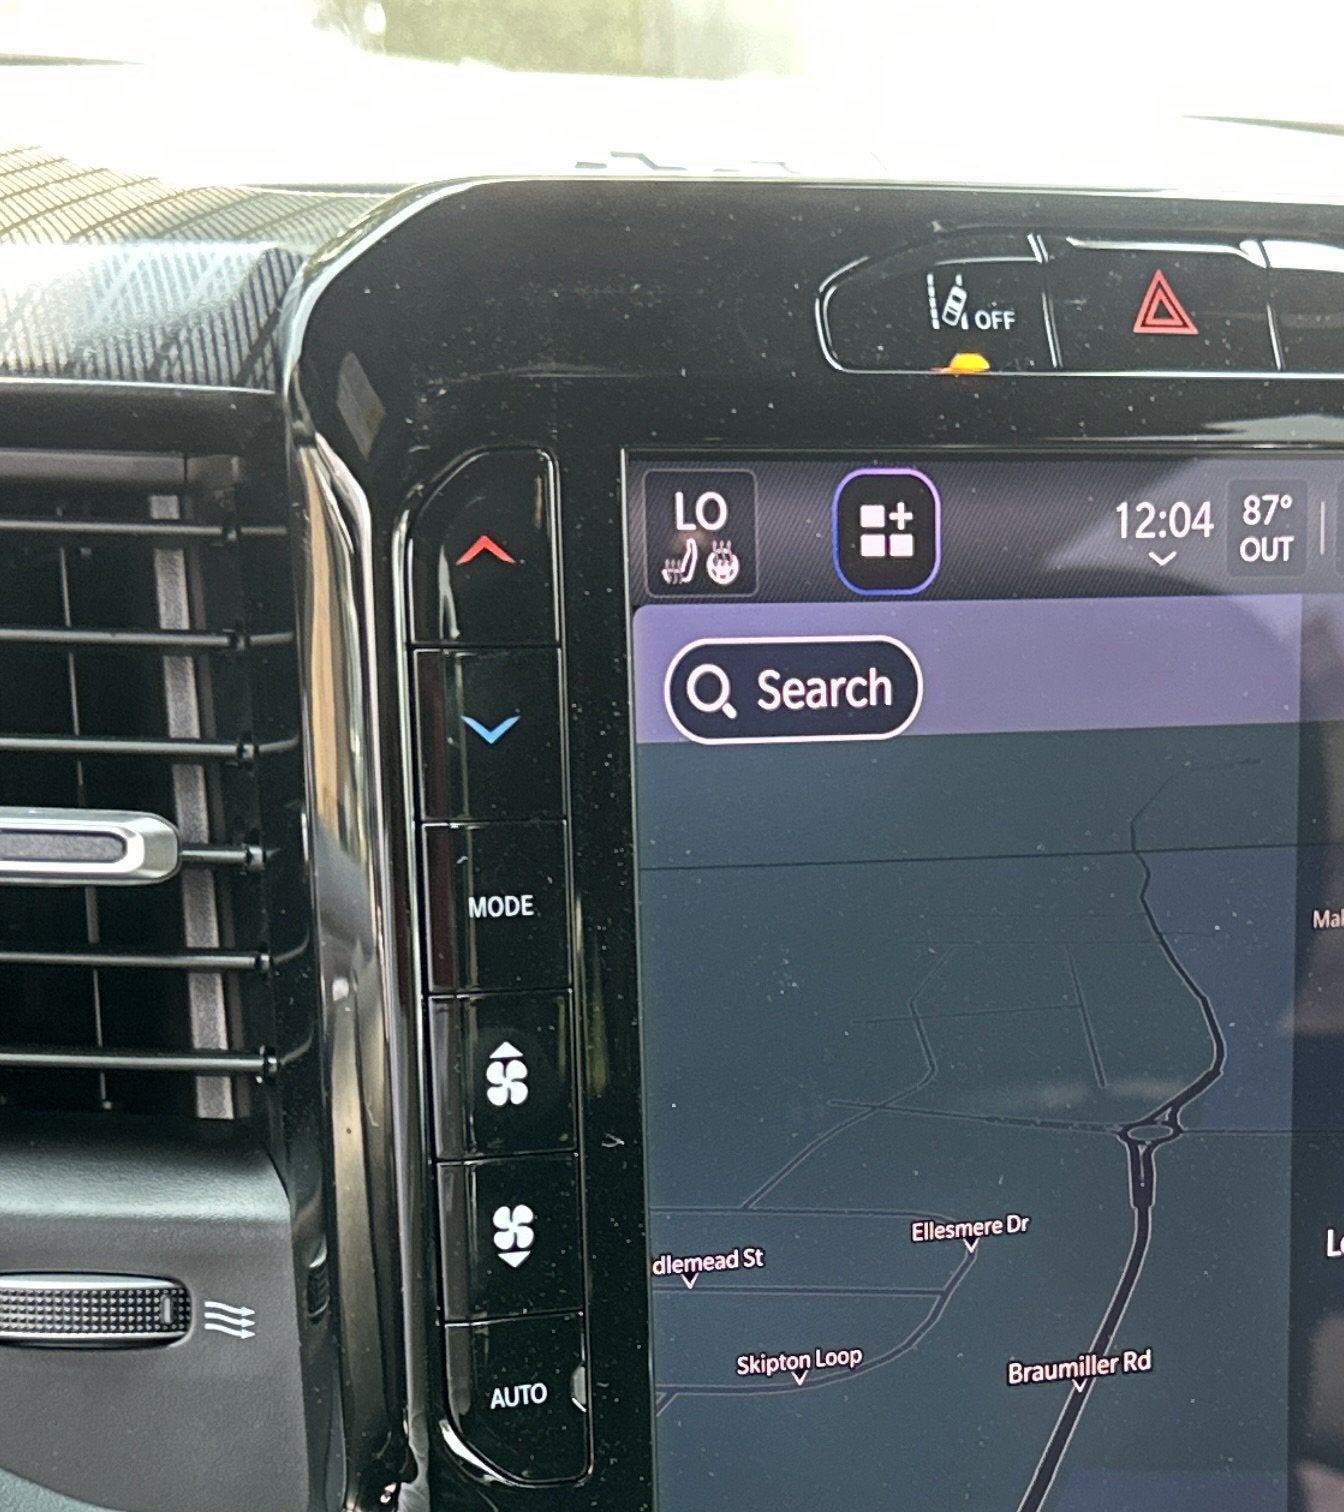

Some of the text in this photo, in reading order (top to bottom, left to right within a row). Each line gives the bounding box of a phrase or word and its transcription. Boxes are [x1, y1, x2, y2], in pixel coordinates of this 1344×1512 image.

[974, 309, 1016, 331] OFF
[674, 491, 728, 532] LO
[1116, 501, 1215, 539] 12:04
[1239, 536, 1295, 562] OUT
[757, 667, 893, 713] Search
[468, 895, 534, 918] MODE
[911, 1214, 1030, 1243] Ellesmere Dr
[652, 1247, 764, 1275] dlemead St
[736, 1347, 863, 1376] Skipton Loop
[1008, 1349, 1152, 1385] Braumiller Rd
[490, 1383, 547, 1409] AUTO
